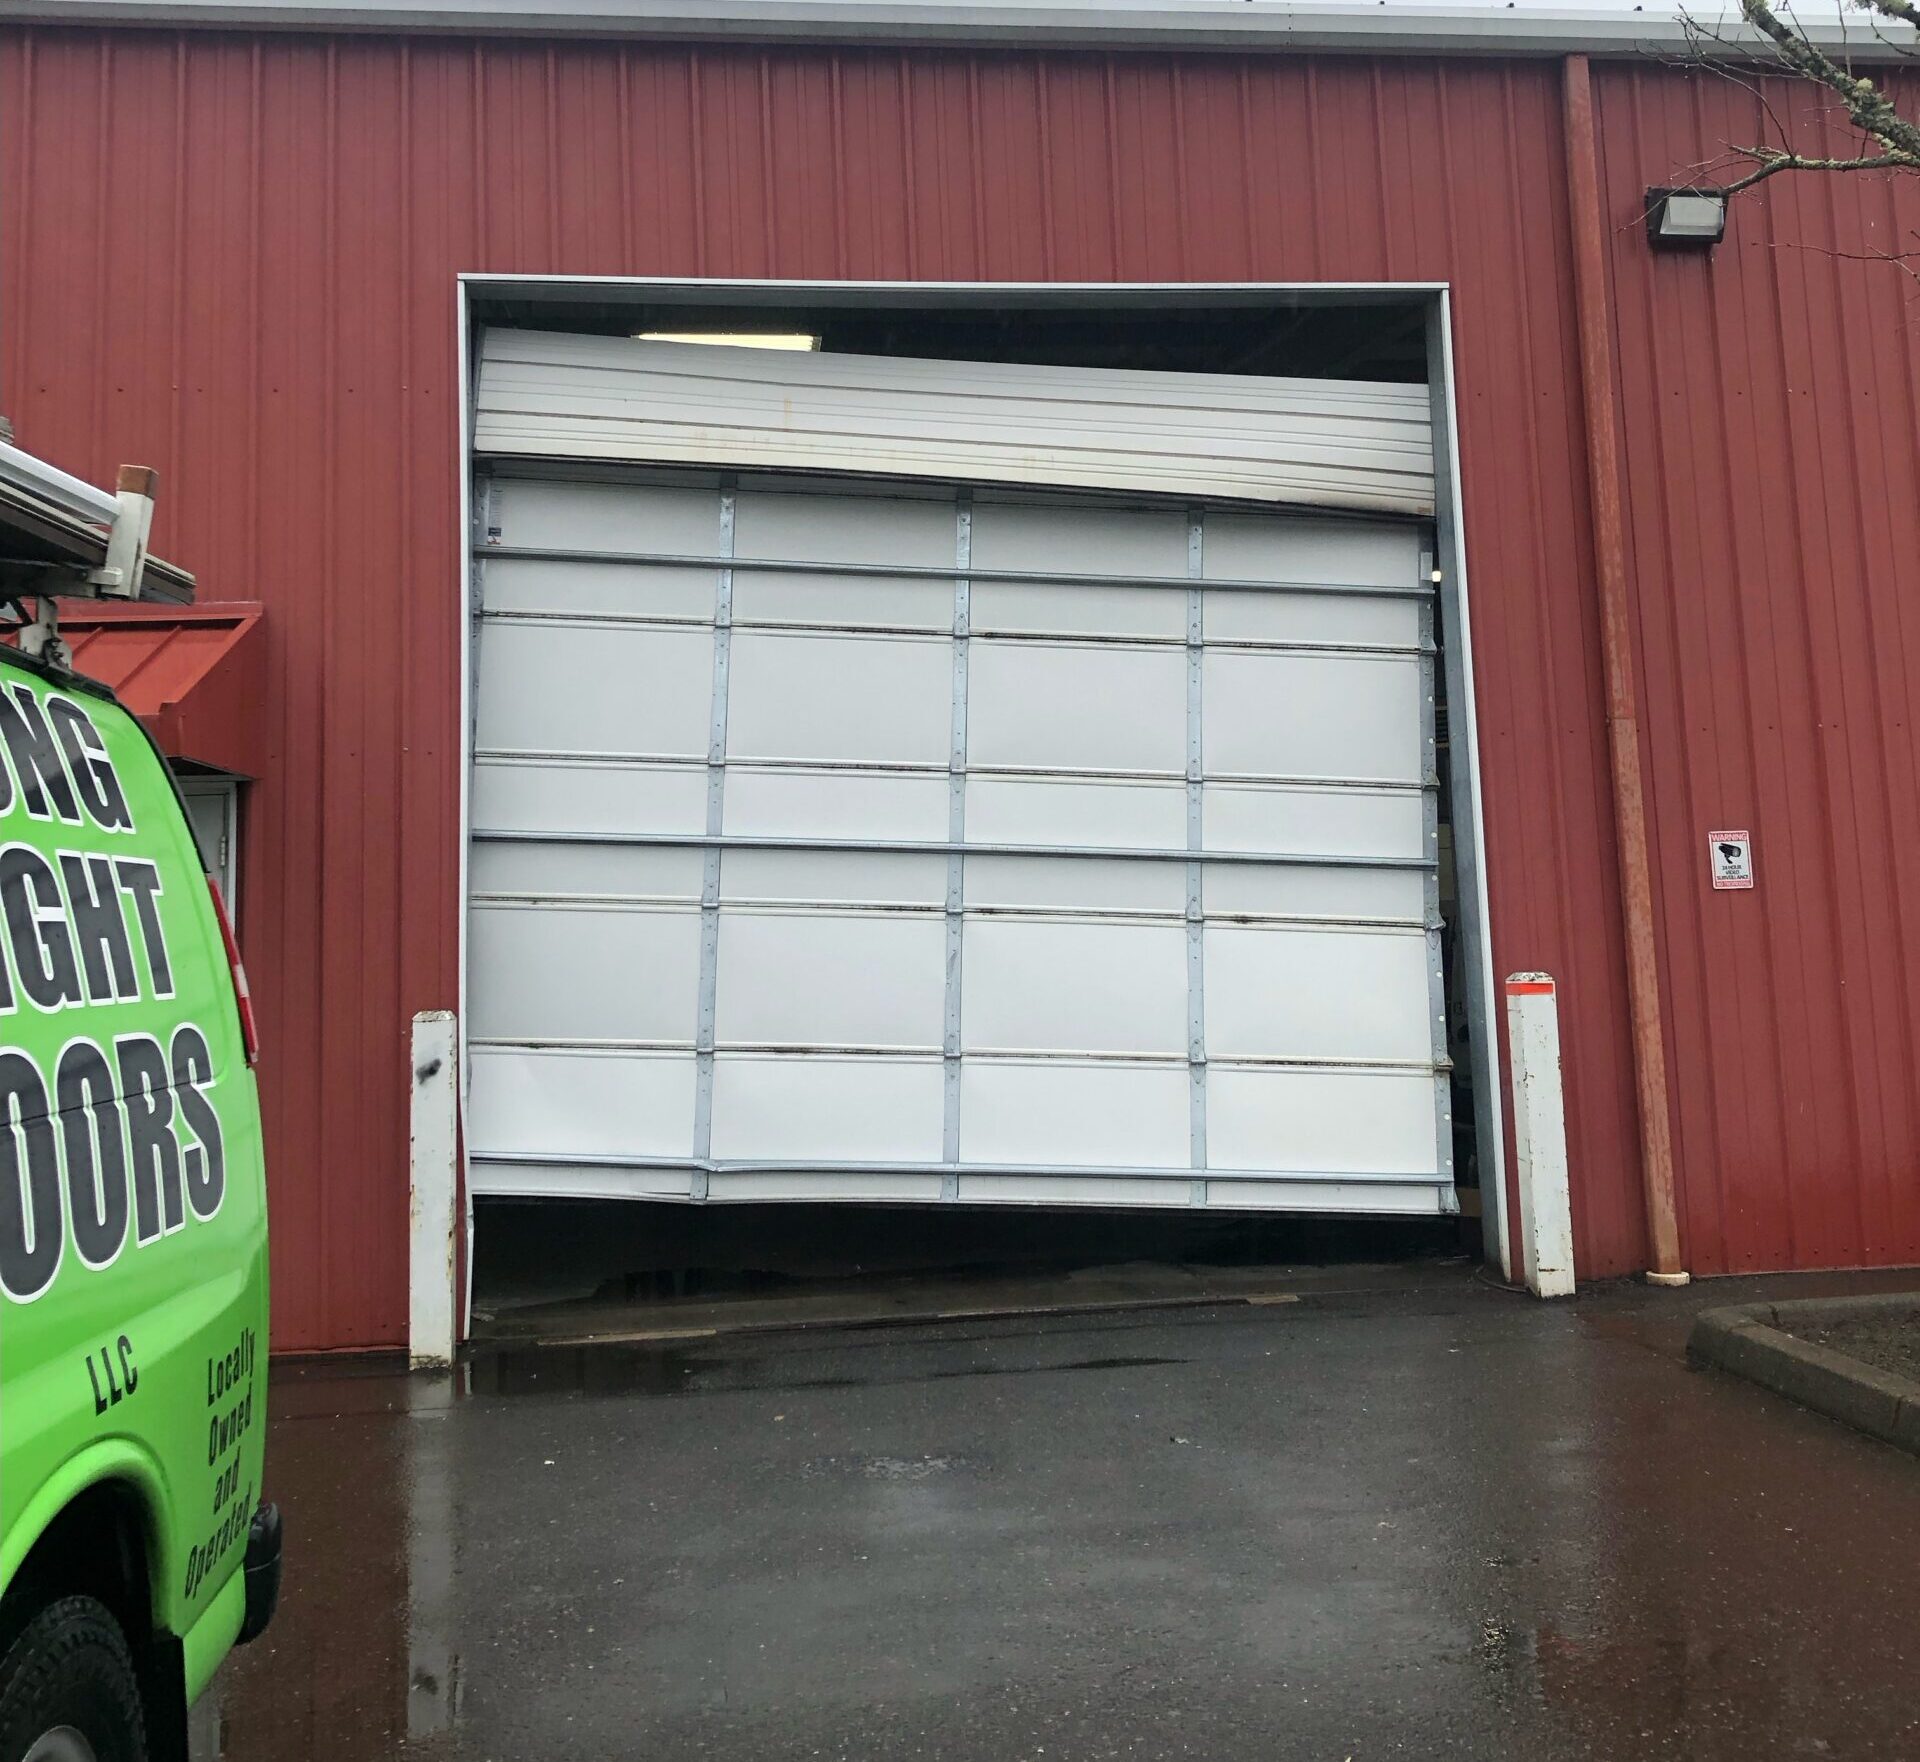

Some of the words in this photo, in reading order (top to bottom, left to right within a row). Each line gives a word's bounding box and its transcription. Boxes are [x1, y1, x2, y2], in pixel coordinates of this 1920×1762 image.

[1712, 833, 1747, 841] WARNING
[0, 841, 176, 1016] GHT
[85, 1334, 139, 1417] LLC
[207, 1326, 256, 1408] Locally
[208, 1382, 253, 1467] Owned
[213, 1446, 241, 1516] and
[184, 1481, 253, 1600] Operated
